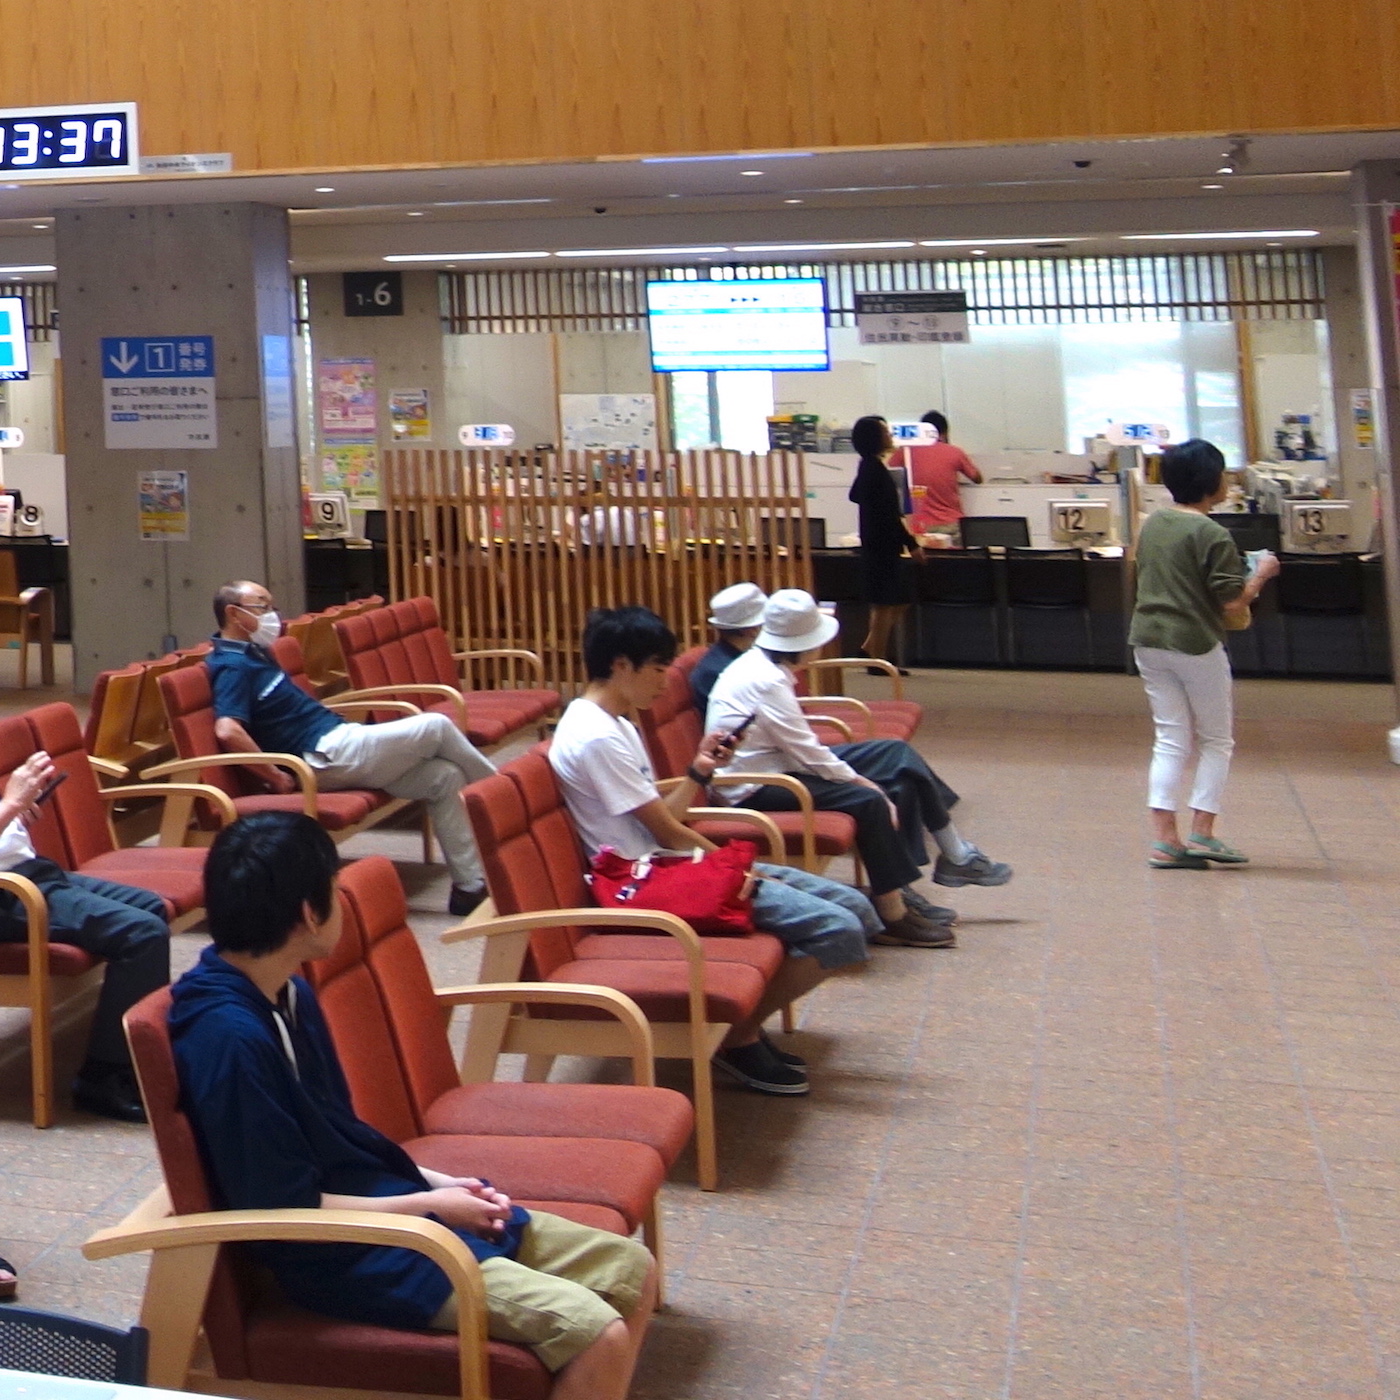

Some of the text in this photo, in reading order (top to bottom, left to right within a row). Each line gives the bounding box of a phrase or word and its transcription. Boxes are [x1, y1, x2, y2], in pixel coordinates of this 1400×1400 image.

[355, 282, 392, 307] 1-6
[322, 502, 334, 521] 9
[1059, 509, 1083, 530] 12
[1299, 509, 1324, 533] 13
